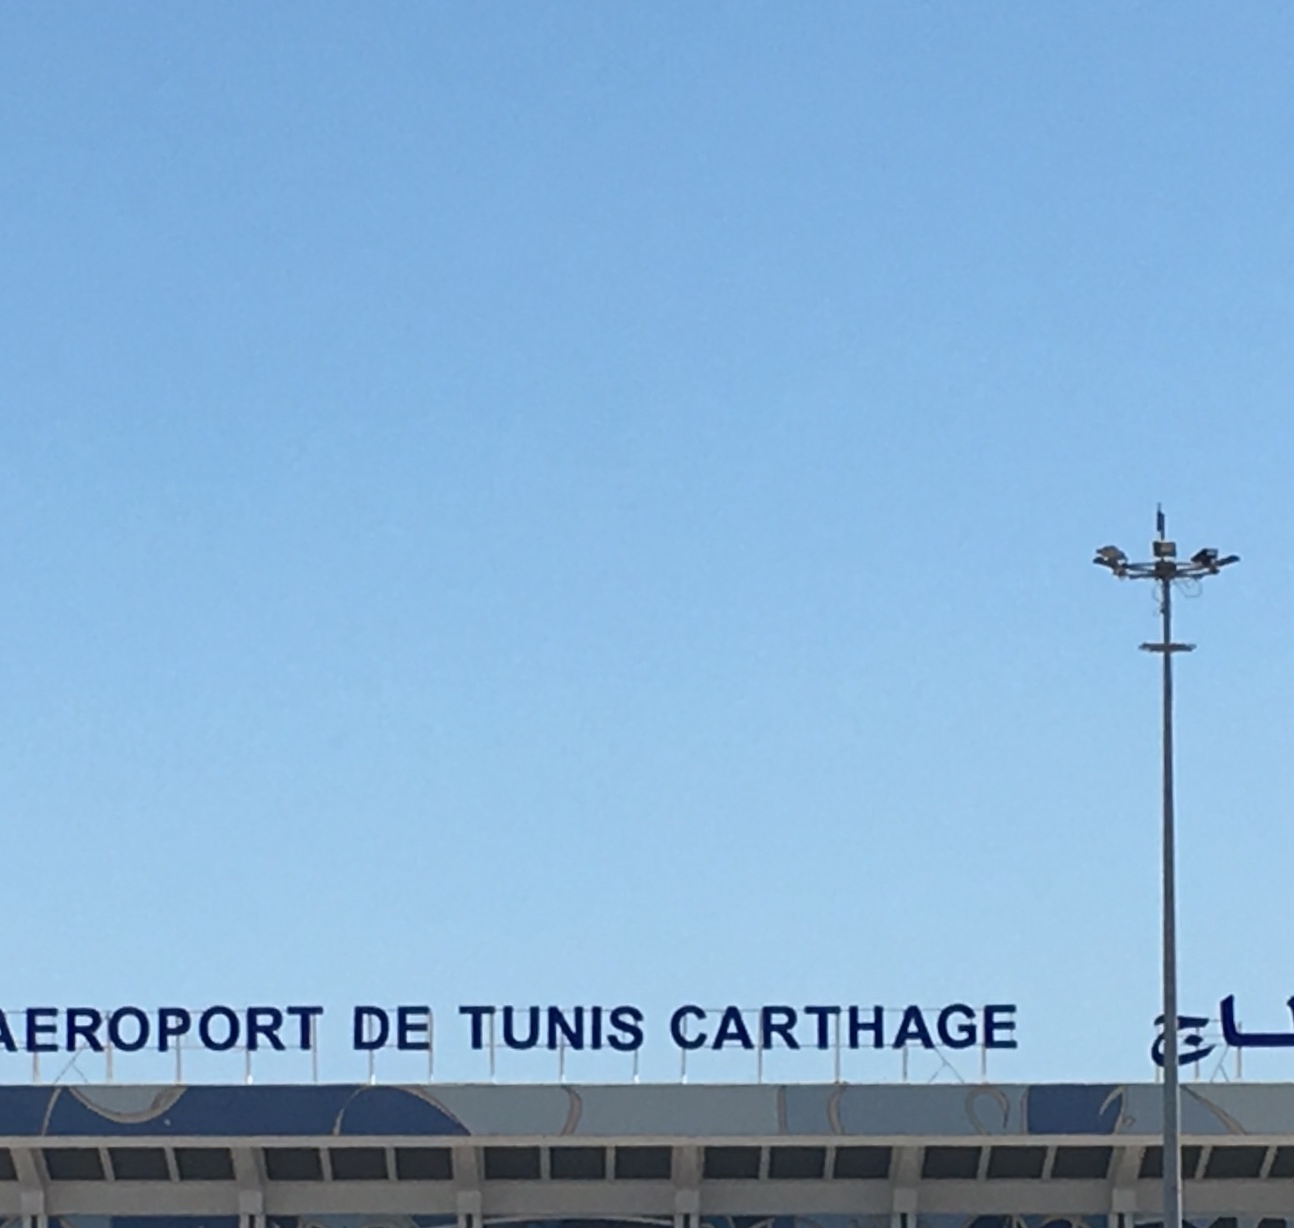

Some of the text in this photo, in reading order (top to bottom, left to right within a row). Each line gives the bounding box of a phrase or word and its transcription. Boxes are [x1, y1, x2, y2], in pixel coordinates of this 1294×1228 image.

[352, 1005, 431, 1051] DE
[459, 1004, 644, 1052] TUNIS
[670, 1003, 1018, 1051] CARTHAGE
